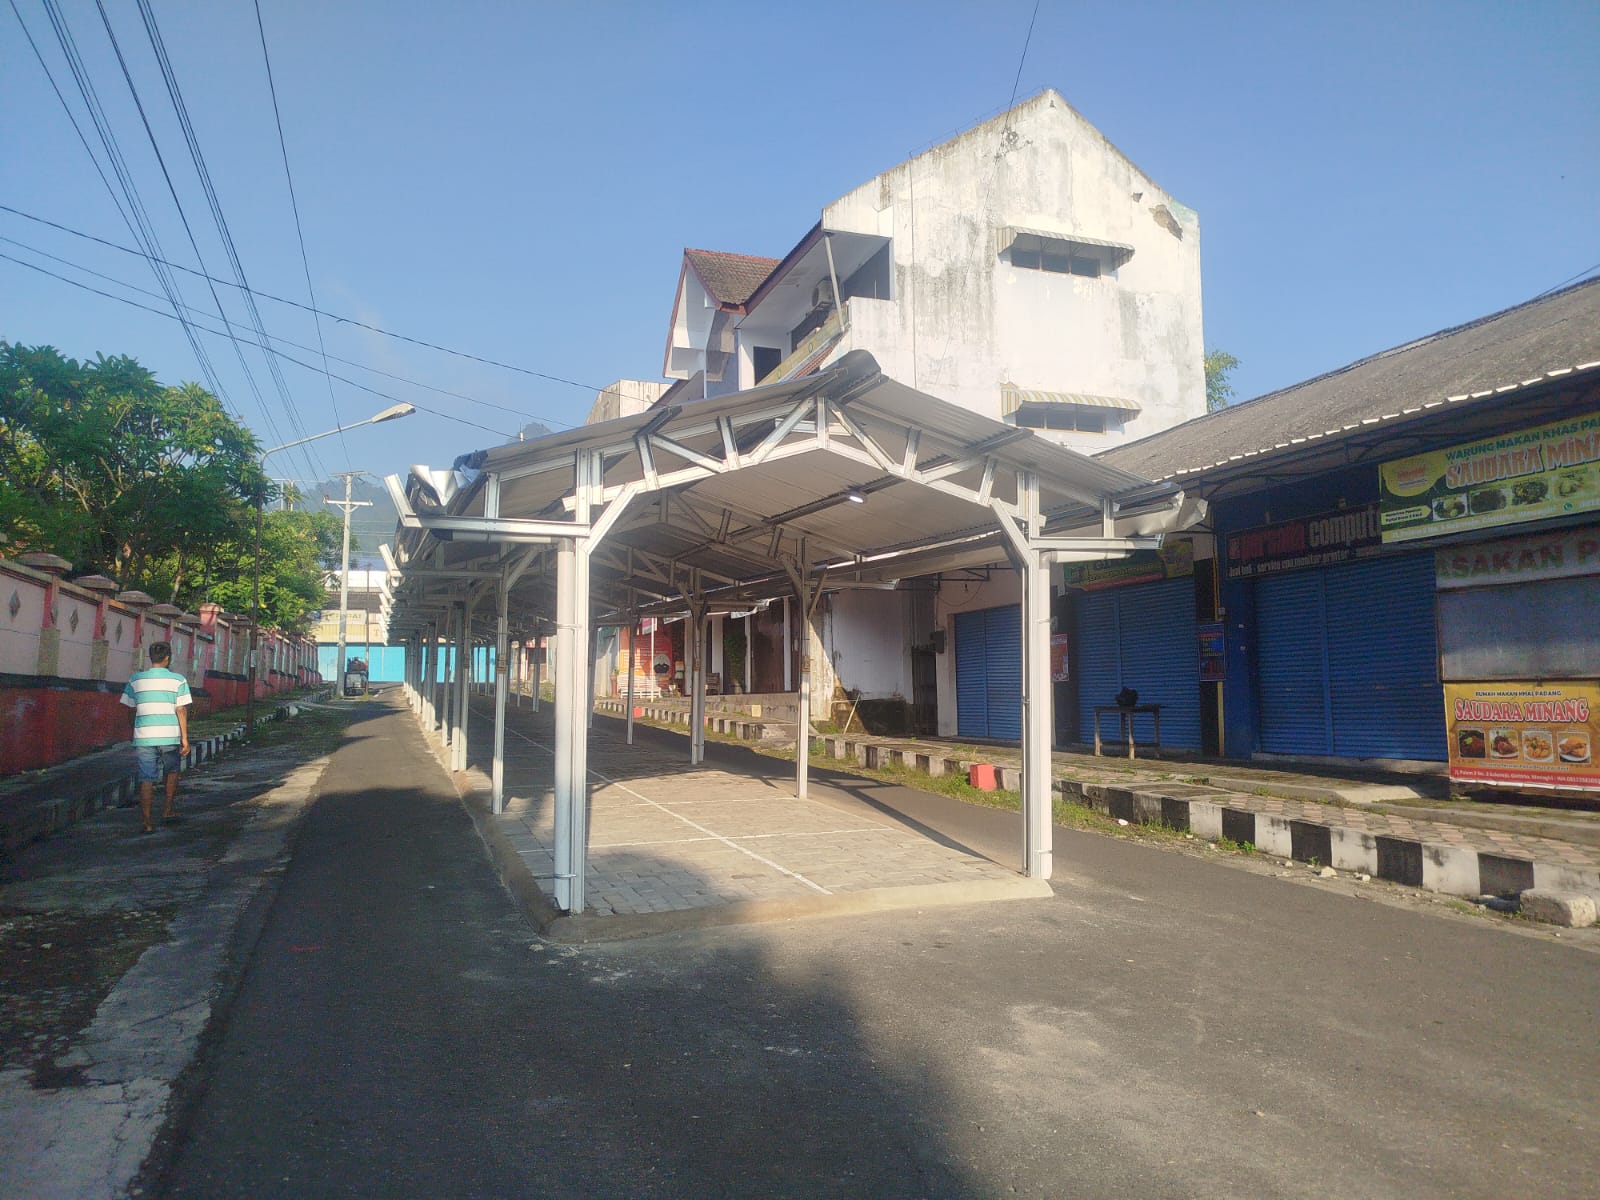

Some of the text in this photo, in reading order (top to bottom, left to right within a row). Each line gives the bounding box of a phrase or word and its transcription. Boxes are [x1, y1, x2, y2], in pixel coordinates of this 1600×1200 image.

[1446, 415, 1600, 460] WARUNG MAKAN KHAS PA
[1446, 445, 1544, 489] SAUDARA
[1454, 698, 1590, 723] SAUDARA MINANG
